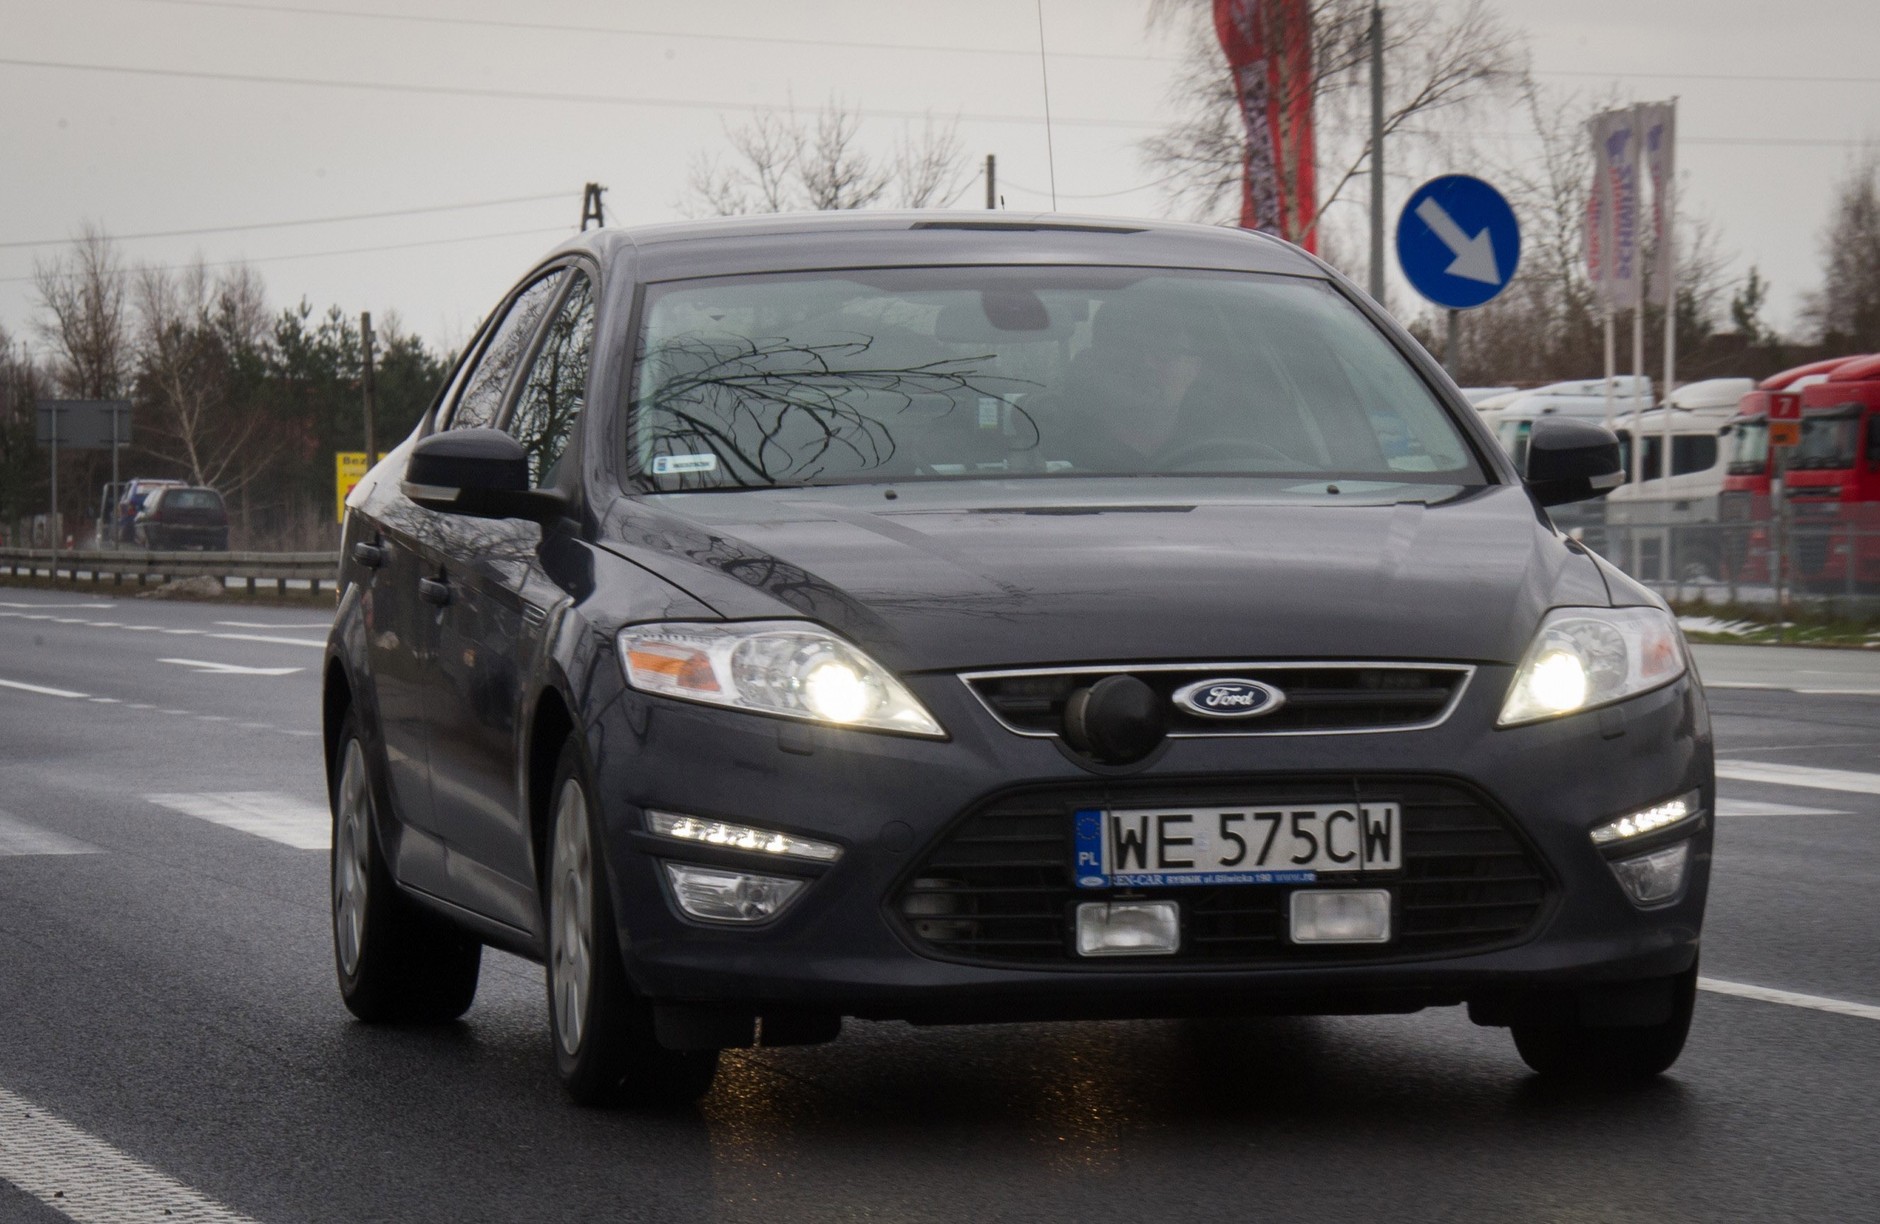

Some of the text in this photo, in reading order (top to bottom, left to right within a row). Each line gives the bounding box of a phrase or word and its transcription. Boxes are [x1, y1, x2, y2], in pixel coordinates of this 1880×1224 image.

[1205, 686, 1255, 706] Ford
[1112, 807, 1392, 870] WE 575CW
[1078, 851, 1099, 866] PL
